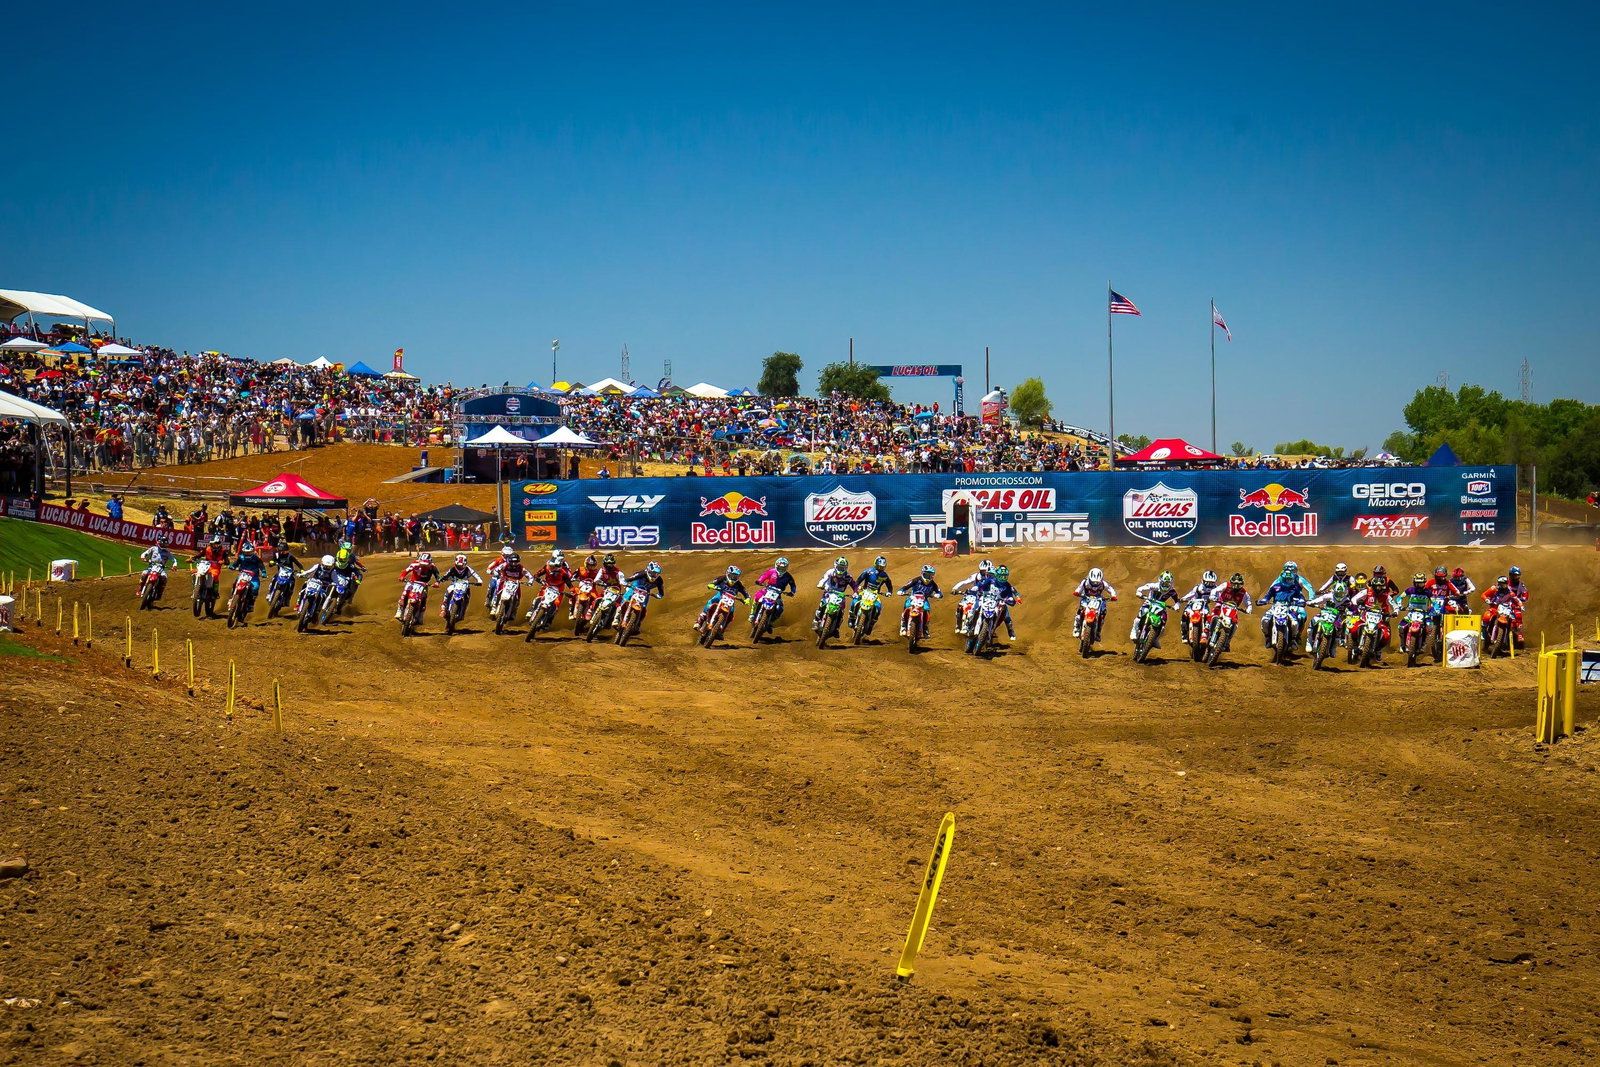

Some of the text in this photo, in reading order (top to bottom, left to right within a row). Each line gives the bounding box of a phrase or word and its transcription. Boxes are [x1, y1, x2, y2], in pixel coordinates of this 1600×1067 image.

[892, 366, 938, 375] LUCAS OIL
[955, 476, 1043, 486] PROMOTOCROSS.COM
[1352, 483, 1426, 498] GEICO
[951, 490, 1053, 510] CAS OIL
[1368, 498, 1425, 508] Motorcycle
[41, 506, 85, 527] LUCAS OIL
[813, 505, 872, 521] LUCAS
[1132, 503, 1193, 517] LUCAS
[89, 516, 138, 538] LUCAS OIL
[809, 524, 872, 532] OIL PRODUCTS
[1229, 513, 1318, 536] Red Bull
[1354, 517, 1388, 530] MX
[1390, 516, 1429, 529] ATV
[176, 532, 192, 546] OIL
[597, 526, 660, 546] WPS
[692, 521, 775, 544] Red Bull
[909, 522, 1090, 543] MOOCROSS
[1364, 529, 1413, 537] ALL OUT
[722, 595, 735, 606] 28
[910, 598, 923, 607] 45
[1323, 613, 1336, 622] 35
